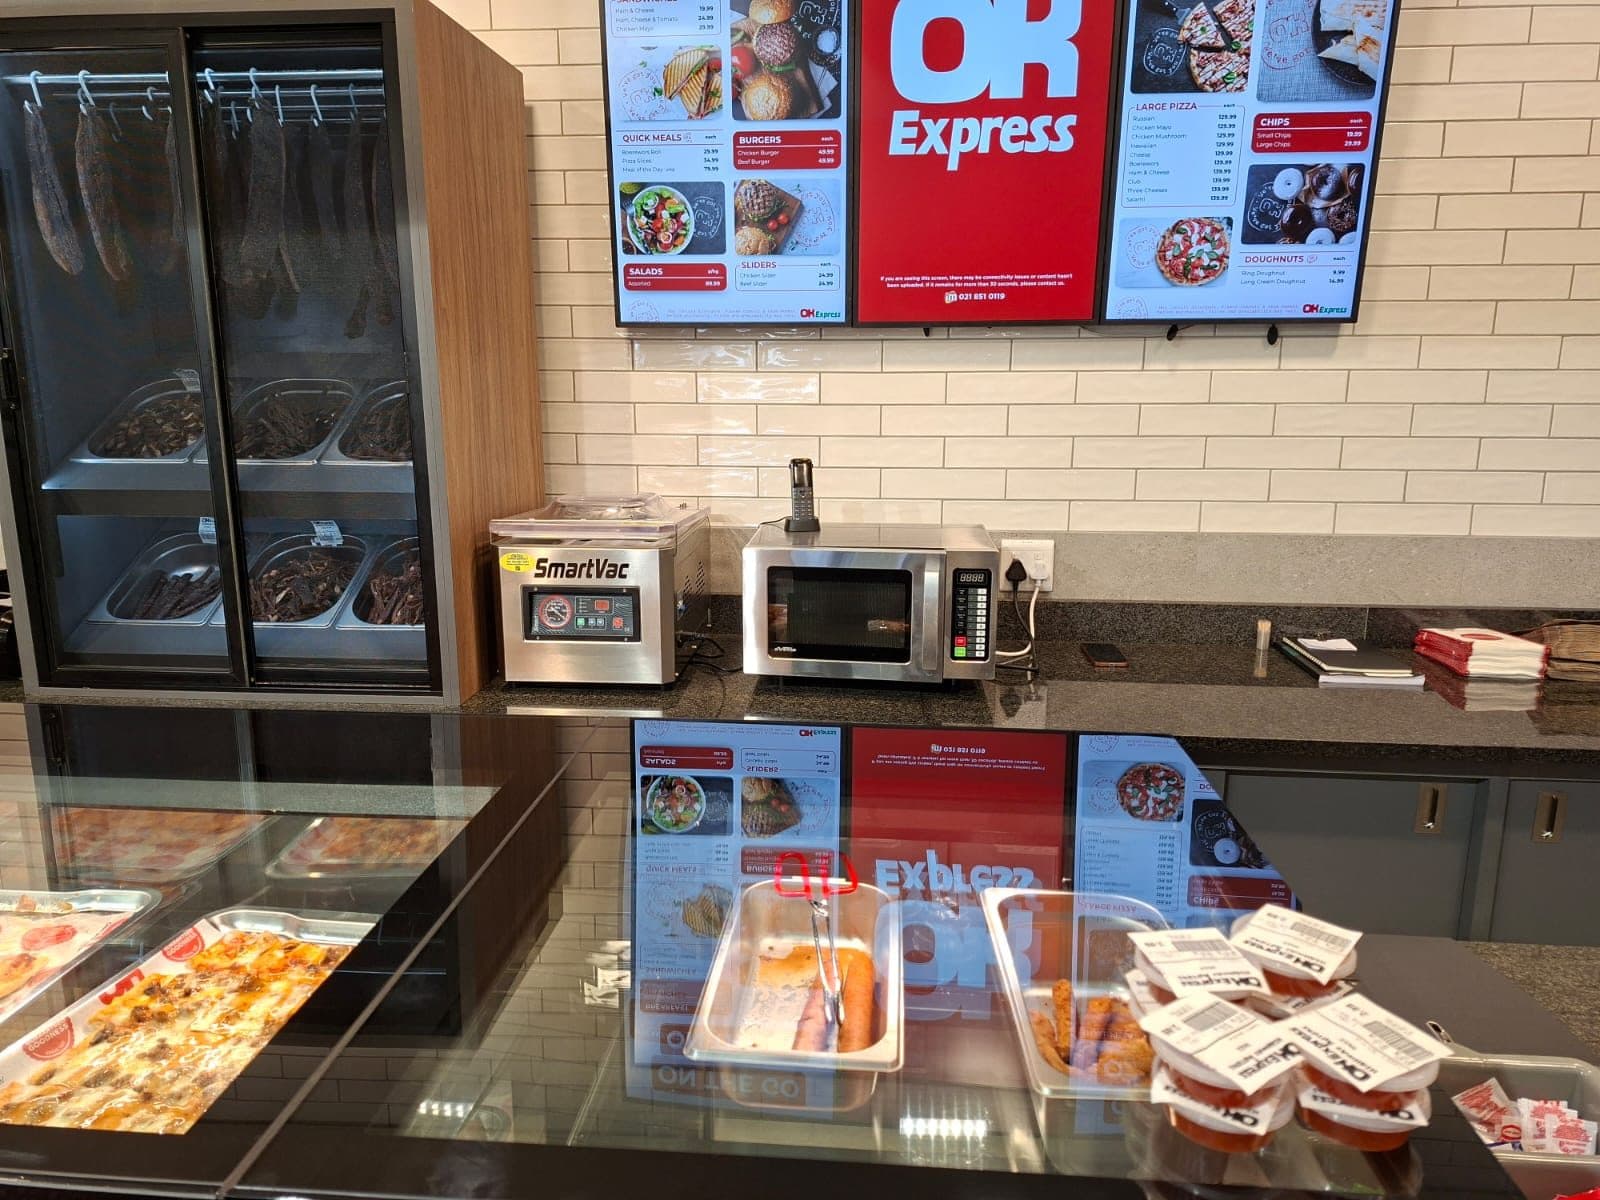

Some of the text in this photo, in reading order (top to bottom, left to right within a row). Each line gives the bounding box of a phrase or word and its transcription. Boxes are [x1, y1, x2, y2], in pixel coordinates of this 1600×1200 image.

[890, 0, 1082, 104] OK
[1136, 102, 1168, 110] LARGE
[1170, 102, 1198, 110] PIZZA
[1260, 118, 1290, 126] CHIPS
[622, 134, 652, 142] QUICK
[653, 134, 682, 142] MEALS
[740, 136, 782, 144] BURGERS
[888, 110, 1078, 171] Express
[1245, 256, 1304, 264] DOUGHNUTS
[629, 268, 664, 276] SALADS
[1320, 306, 1348, 314] Express
[816, 310, 840, 319] Express
[534, 558, 630, 579] SmartVac
[28, 1020, 69, 1052] GOODNESS
